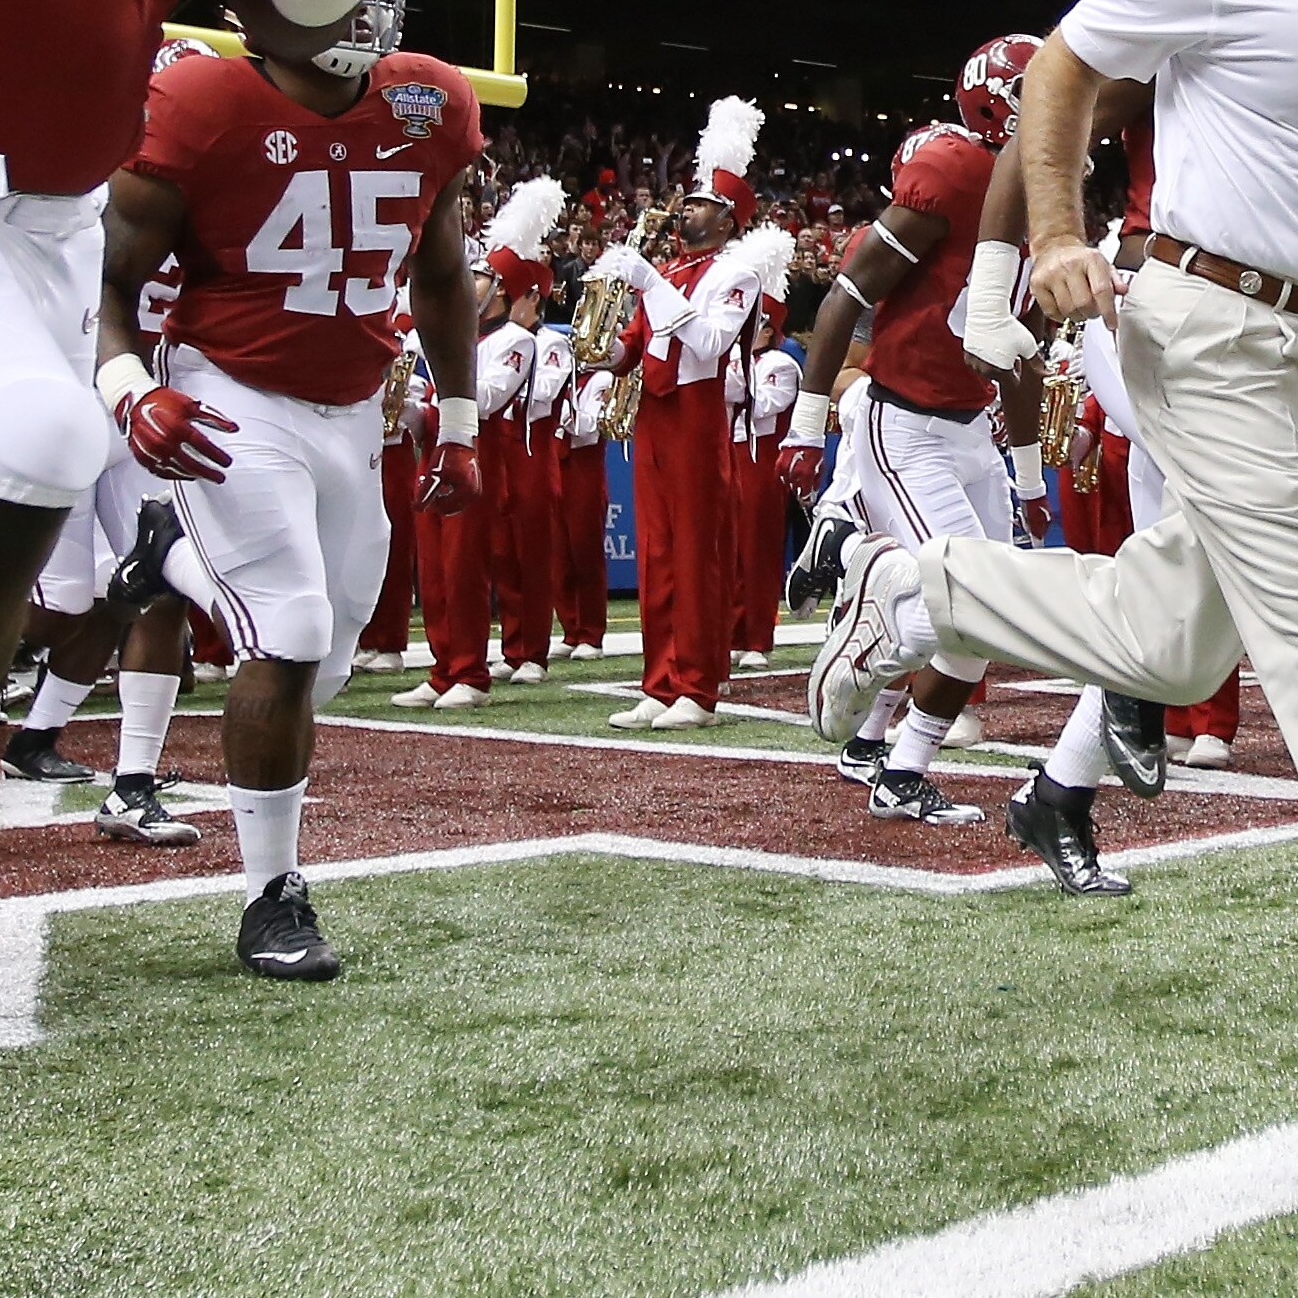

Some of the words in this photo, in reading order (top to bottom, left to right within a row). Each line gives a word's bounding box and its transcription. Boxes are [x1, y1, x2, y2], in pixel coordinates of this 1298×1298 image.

[963, 53, 987, 91] 80
[394, 92, 437, 105] Allstate
[264, 129, 299, 165] SEC
[246, 170, 422, 317] 45
